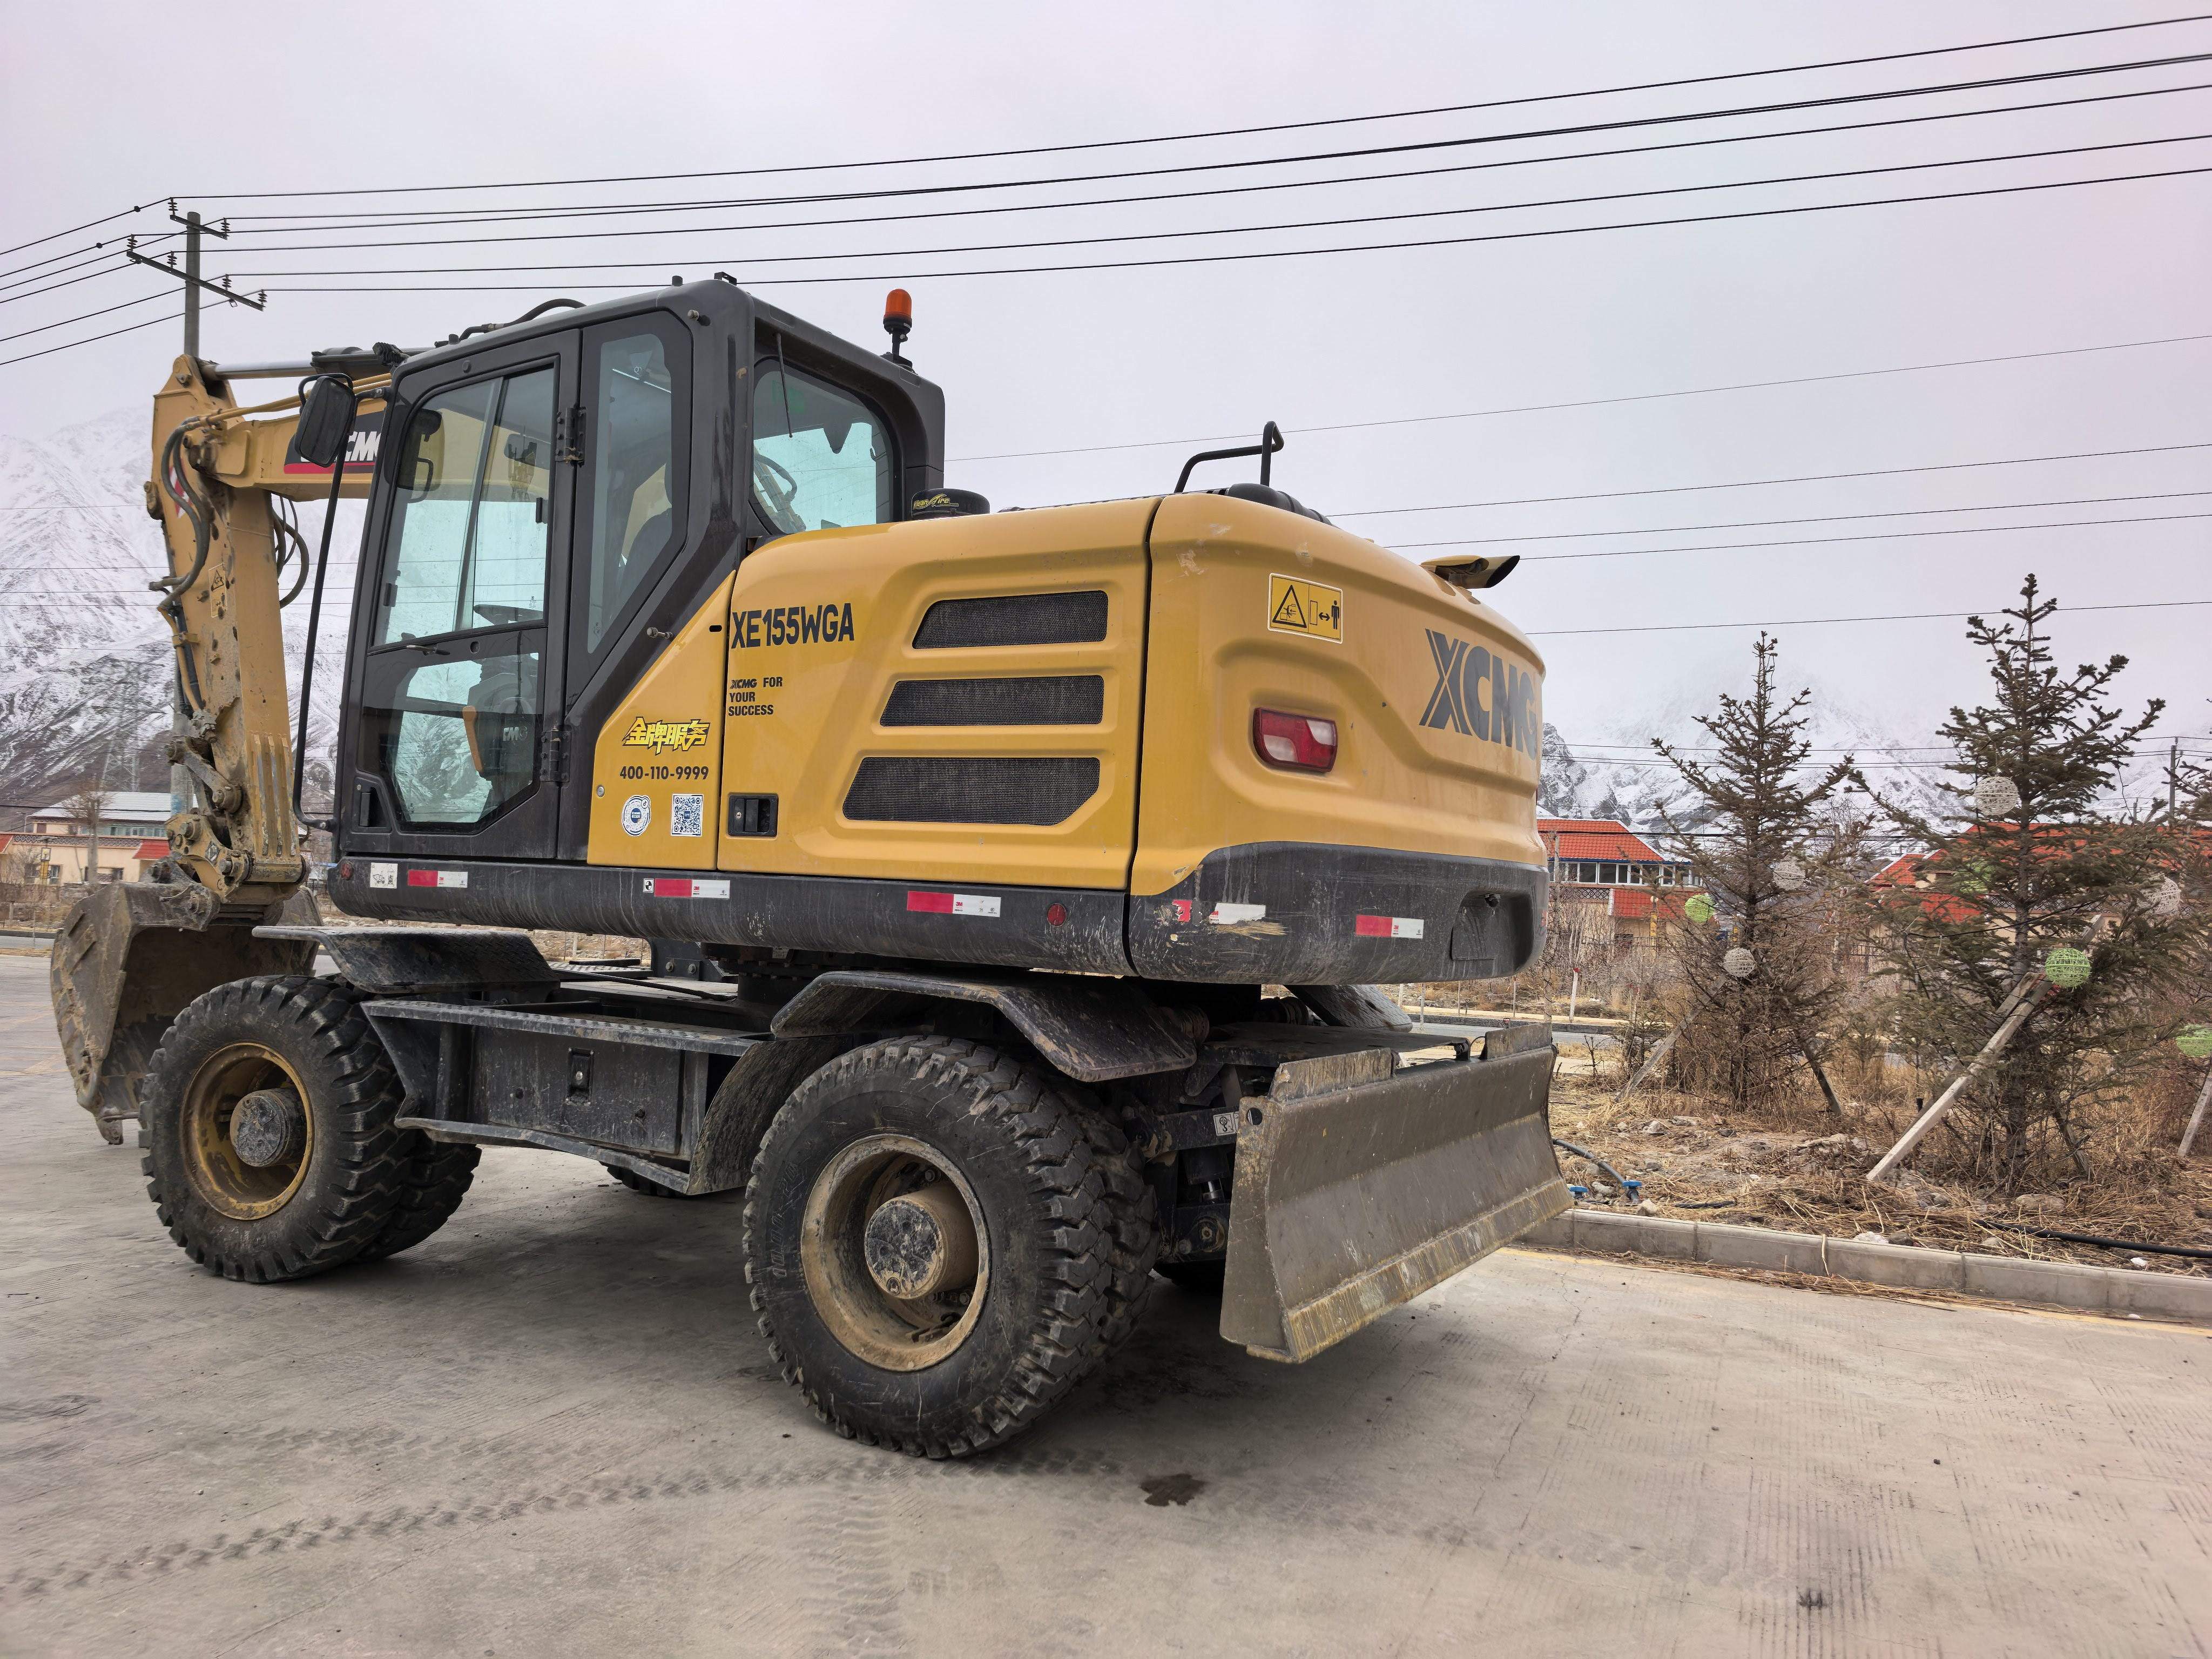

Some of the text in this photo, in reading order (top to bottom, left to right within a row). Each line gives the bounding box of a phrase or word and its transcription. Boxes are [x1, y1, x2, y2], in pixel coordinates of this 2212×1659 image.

[731, 603, 854, 649] XE155WGA
[730, 677, 783, 689] XCMG FOR
[729, 691, 756, 703] YOUR
[1419, 628, 1538, 760] XCMG
[729, 704, 774, 716] SUCCESS
[622, 716, 711, 756] 金牌服务
[619, 766, 709, 780] 400-110-9999
